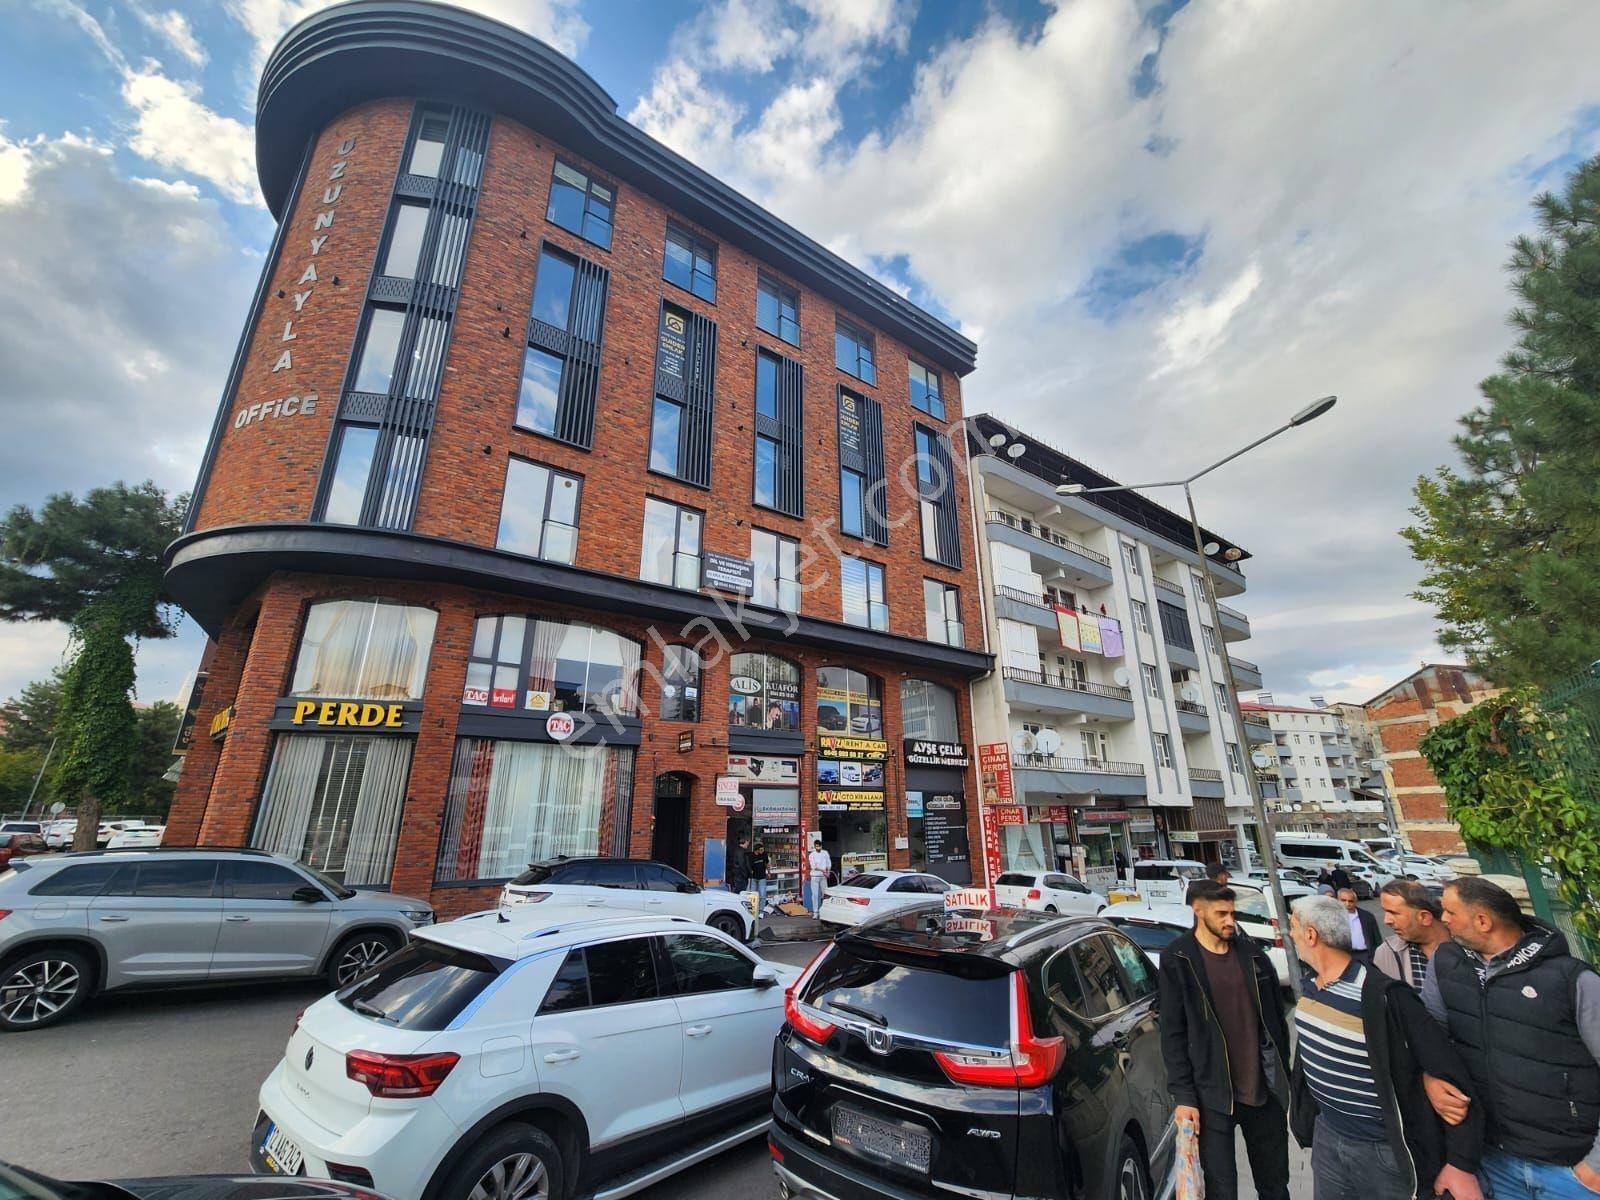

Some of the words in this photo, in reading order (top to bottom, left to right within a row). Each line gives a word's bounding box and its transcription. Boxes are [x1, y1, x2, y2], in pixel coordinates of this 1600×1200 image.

[272, 137, 357, 373] UZUNYAYLA
[292, 701, 403, 727] PERDE
[913, 742, 938, 755] AYŞE
[938, 743, 963, 757] ÇELİK
[908, 755, 940, 764] GÜZELLİK
[982, 763, 1008, 773] PERDE
[945, 892, 989, 907] SATILIK
[966, 1128, 1001, 1139] AWD
